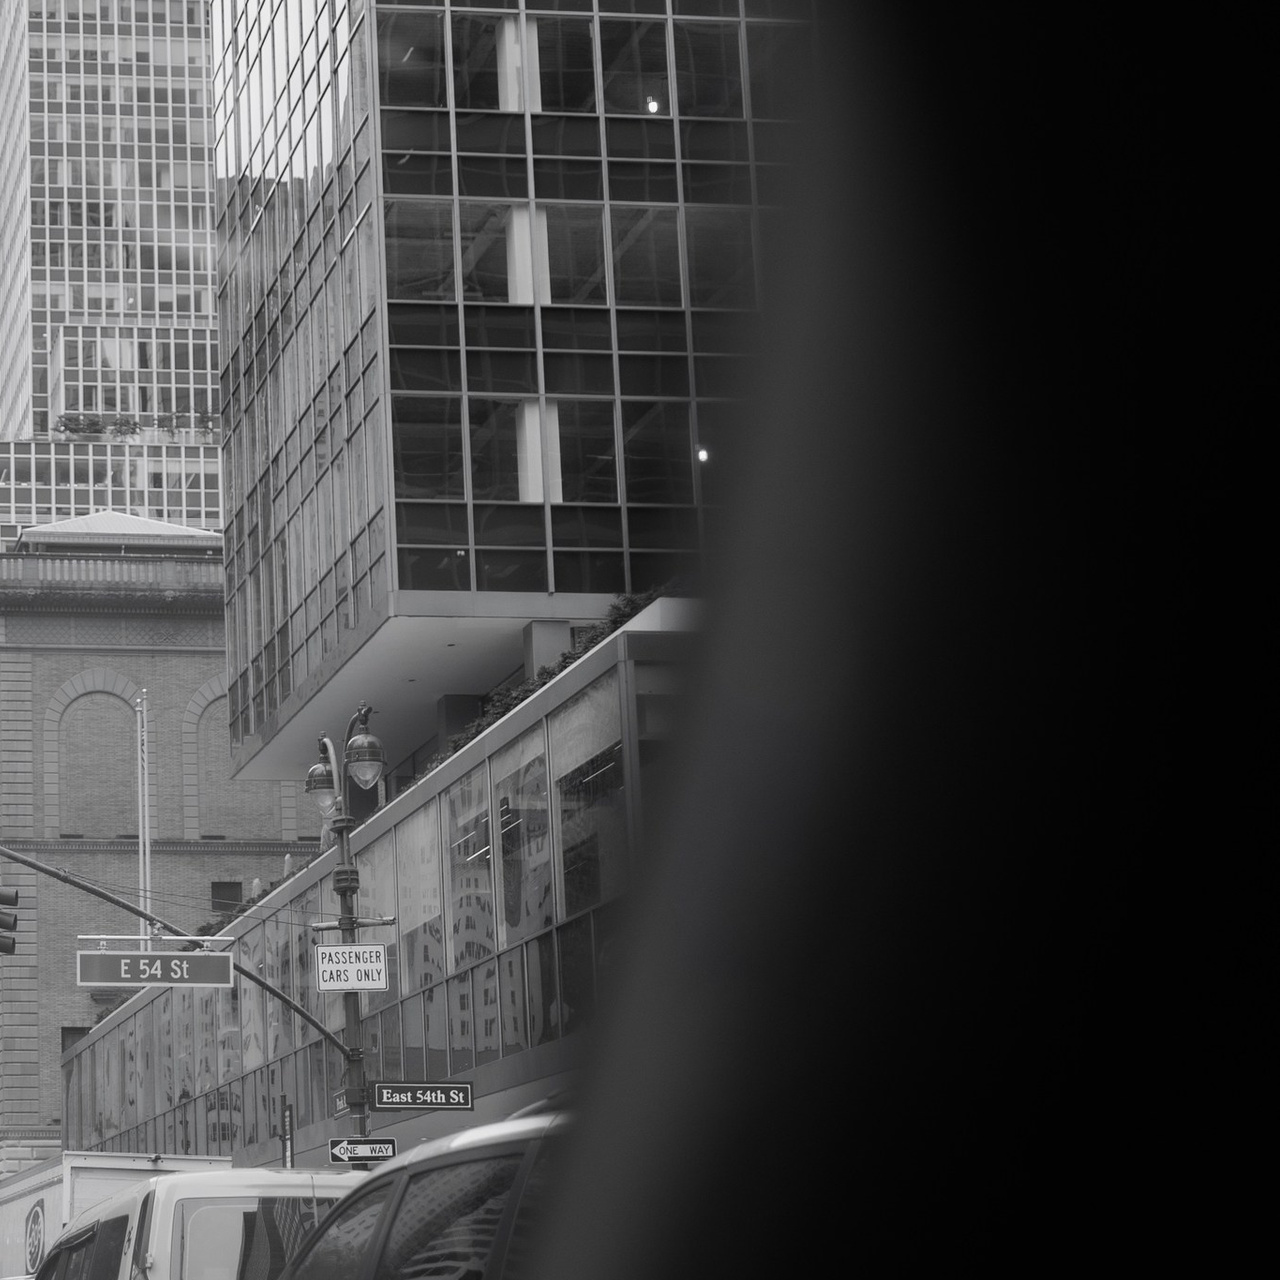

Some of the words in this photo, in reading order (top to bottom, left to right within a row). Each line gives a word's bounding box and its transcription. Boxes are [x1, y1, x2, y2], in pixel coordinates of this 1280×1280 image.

[321, 951, 382, 965] PASSENGER
[120, 959, 131, 978] E
[139, 959, 162, 979] 54
[170, 959, 189, 979] St
[322, 969, 349, 983] CARS
[356, 968, 382, 982] ONLY
[382, 1089, 413, 1103] East
[416, 1090, 446, 1103] 54th
[449, 1089, 465, 1103] St
[338, 1146, 359, 1156] ONE
[370, 1145, 391, 1155] WAY
